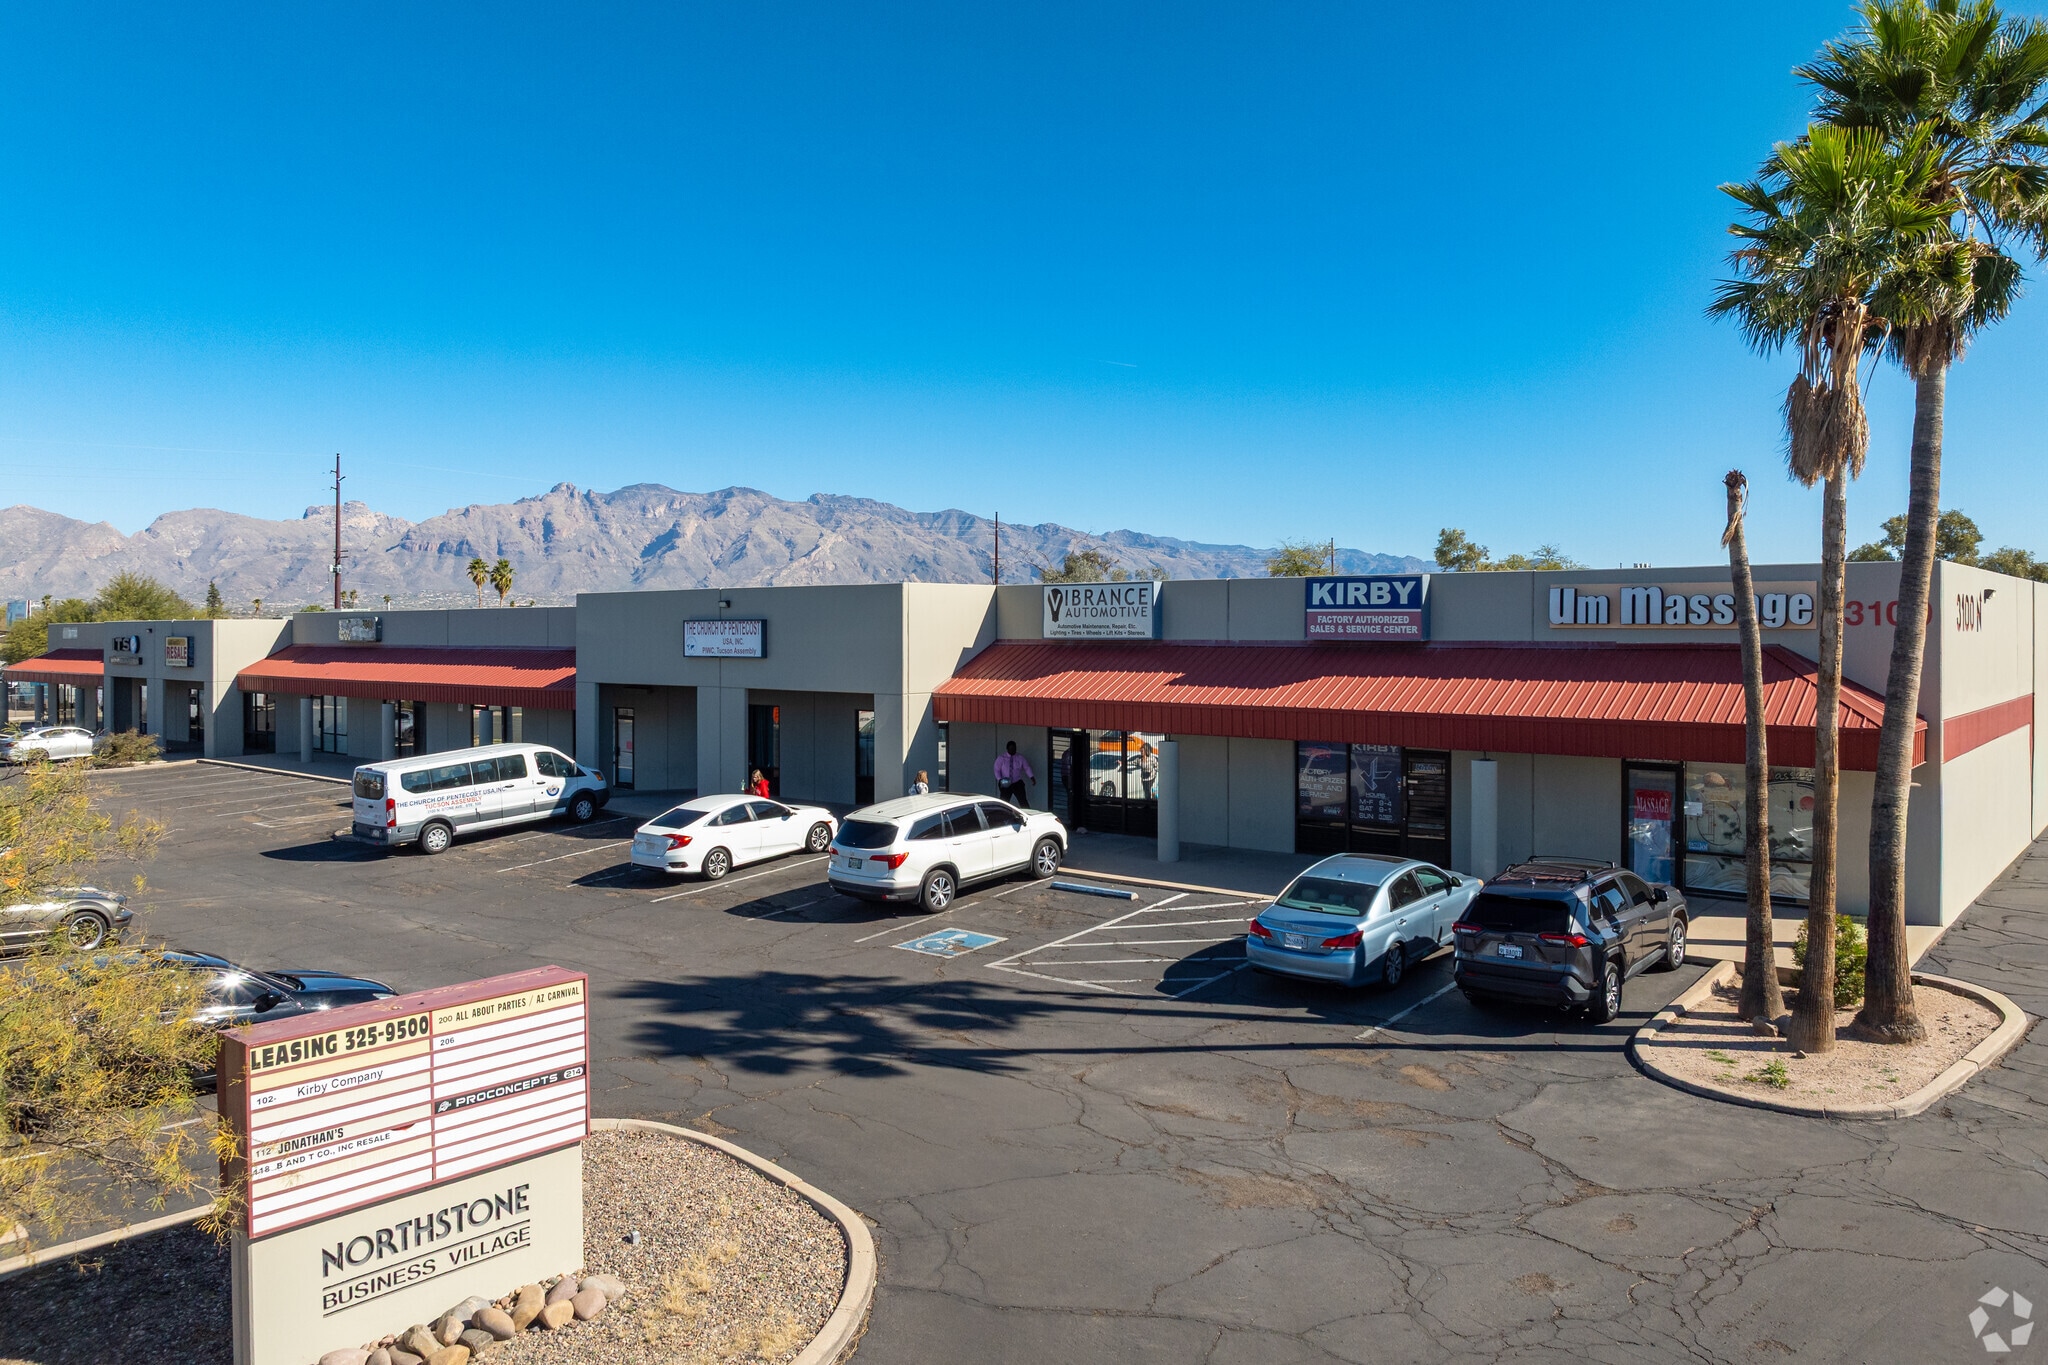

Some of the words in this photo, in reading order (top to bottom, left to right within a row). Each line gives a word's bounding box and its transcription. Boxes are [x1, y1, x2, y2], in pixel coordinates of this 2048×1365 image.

[1312, 581, 1417, 605] KIRBY
[1065, 606, 1148, 618] AUTOMOTIVE
[1317, 615, 1354, 624] FACTORY
[1355, 615, 1410, 624] AUTHORIZED
[1549, 588, 1610, 625] Um
[1620, 586, 1814, 628] Massge
[1845, 600, 1933, 626] 310
[1956, 593, 1975, 632] 3100
[686, 621, 696, 635] THE
[697, 621, 719, 635] CHURCH
[720, 621, 727, 635] OF
[728, 621, 761, 635] PENTECOST
[1310, 625, 1336, 633] SALES
[1337, 625, 1344, 633] &
[1346, 625, 1381, 633] SERVICE
[1383, 625, 1418, 634] CENTER
[166, 646, 187, 660] RESALE
[734, 647, 756, 656] Assembly
[409, 797, 436, 807] CHURCH
[446, 790, 482, 801] PENTECOST
[424, 801, 450, 810] TUCSON
[451, 796, 482, 806] ASSEMBLY
[1636, 796, 1669, 814] MASSAGE
[439, 1015, 453, 1024] 200
[456, 1010, 468, 1021] ALL
[472, 1004, 495, 1017] ABOUT
[497, 998, 527, 1012] PARTIES
[536, 993, 545, 1003] AZ
[547, 986, 580, 1001] CARNIVAL
[251, 1034, 338, 1070] LEASING
[345, 1015, 429, 1051] 325-9500
[440, 1037, 455, 1046] 206
[297, 1082, 328, 1097] Kirby
[331, 1070, 384, 1088] Company
[455, 1073, 558, 1107] PROCONCEPTS
[565, 1068, 582, 1078] 214
[256, 1148, 272, 1158] 112
[278, 1128, 344, 1154] JONATHAN'S
[286, 1155, 306, 1167] AND
[309, 1153, 315, 1161] T
[317, 1149, 336, 1158] CO.,
[338, 1142, 354, 1152] INC
[356, 1132, 391, 1146] RESALE
[322, 1183, 530, 1278] NORTHSTONE
[323, 1258, 436, 1310] BUSINESS
[449, 1227, 531, 1265] VILLAGE
